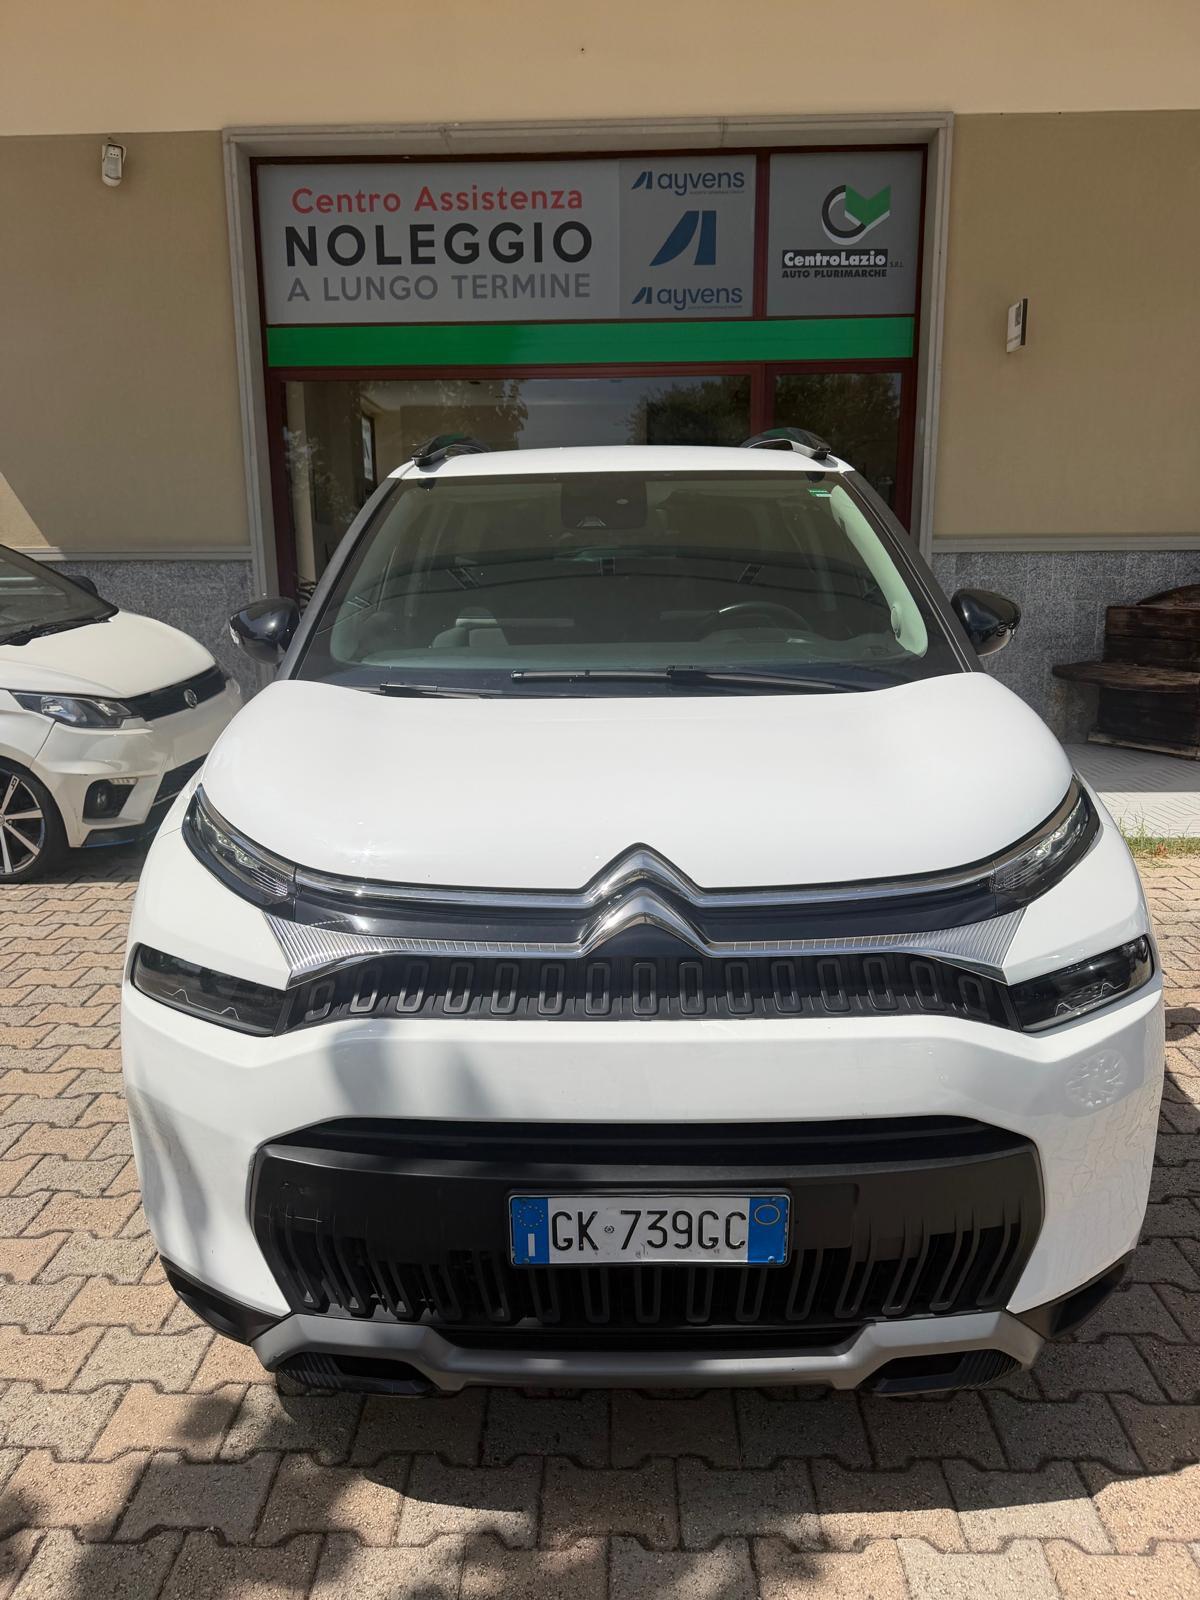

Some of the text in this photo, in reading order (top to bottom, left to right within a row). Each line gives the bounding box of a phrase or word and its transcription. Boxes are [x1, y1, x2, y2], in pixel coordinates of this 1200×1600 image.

[657, 171, 745, 196] ayvens
[291, 185, 583, 214] Centro Assistenza
[285, 221, 592, 267] NOLEGGIO
[783, 251, 887, 268] CentroLazio
[782, 268, 887, 279] AUTO PLURIMARCHE
[287, 273, 591, 302] A LUNGO TERMINE
[657, 287, 743, 311] ayvens
[551, 1210, 600, 1252] GK
[620, 1209, 747, 1251] 739GC
